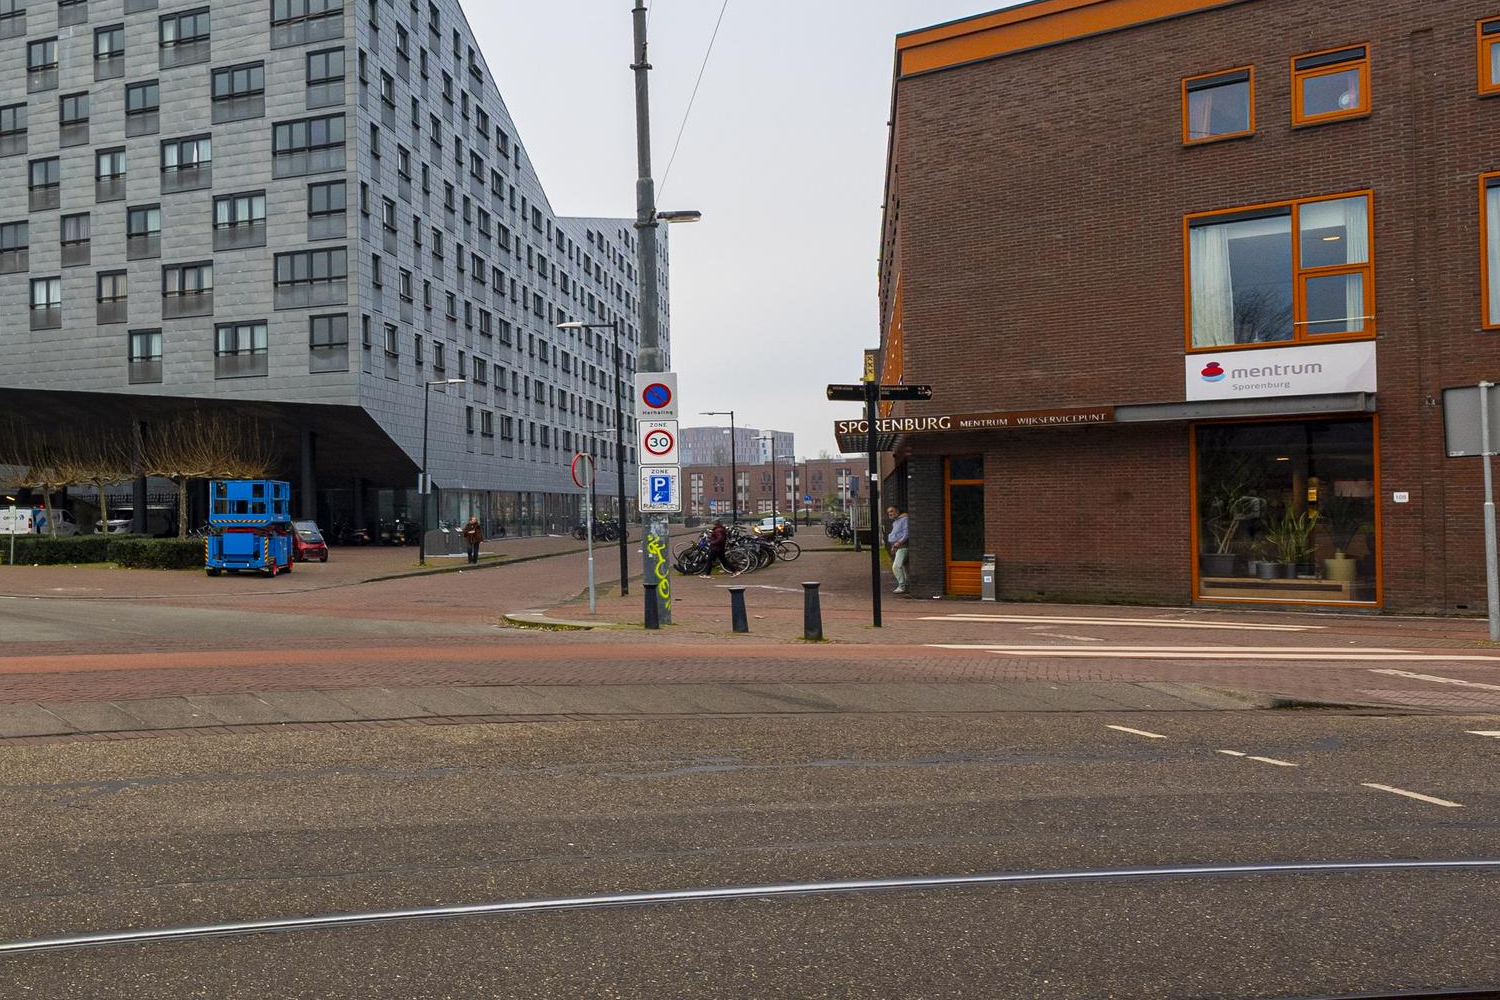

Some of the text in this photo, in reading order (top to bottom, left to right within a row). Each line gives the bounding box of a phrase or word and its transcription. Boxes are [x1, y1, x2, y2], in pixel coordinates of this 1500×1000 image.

[1231, 362, 1322, 379] mentrum
[1232, 381, 1291, 391] Sporenburg
[839, 413, 1107, 434] SPORENBURG MENTRUM WIJKSERVICEPUNT
[650, 437, 669, 447] 30
[654, 477, 666, 491] P
